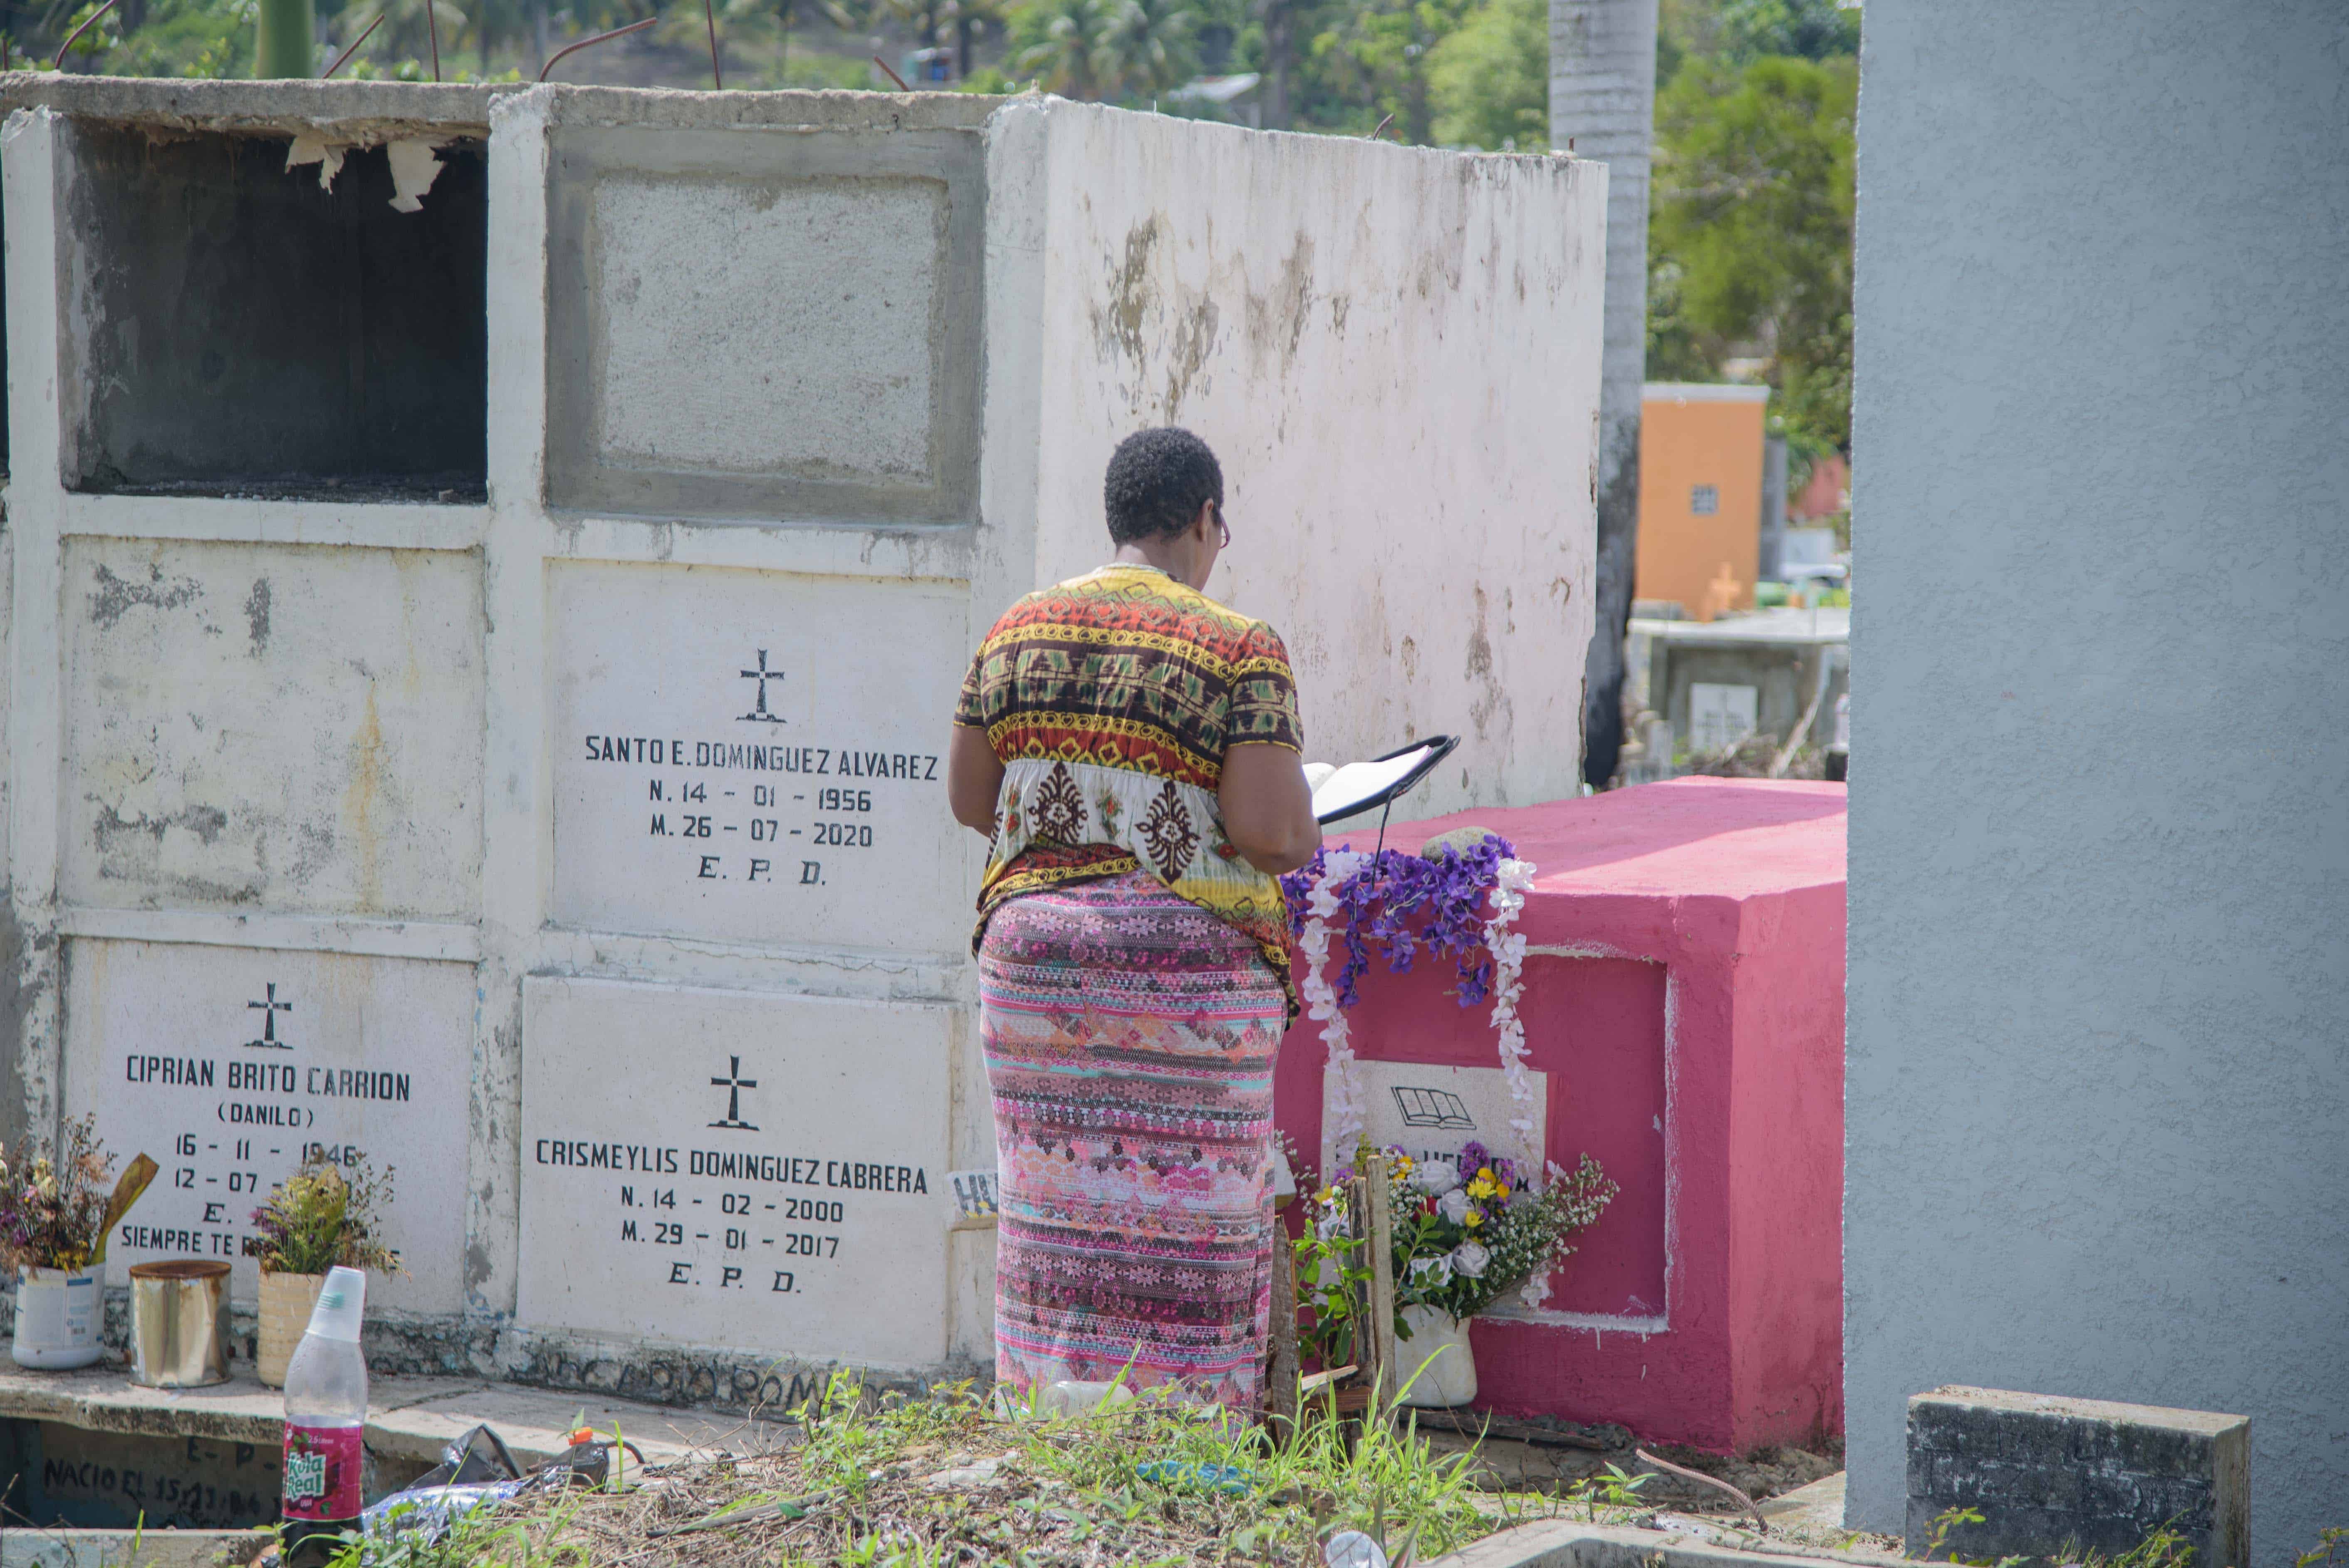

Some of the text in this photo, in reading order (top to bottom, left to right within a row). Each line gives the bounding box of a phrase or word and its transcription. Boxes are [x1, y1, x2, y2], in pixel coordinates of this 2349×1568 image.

[585, 735, 663, 764] SANTO
[696, 742, 830, 775] DOMINGUEZ
[838, 750, 938, 781] ALVAREZ
[683, 781, 708, 804] 14
[753, 784, 775, 807] 01
[819, 788, 871, 812] 1956
[683, 815, 712, 838] 26
[750, 818, 778, 842] 07
[813, 822, 872, 848] 2020
[126, 1055, 410, 1102] CIPRIAN BRITO CARRION
[218, 1103, 314, 1128] (DANILO)
[176, 1133, 196, 1156] 16
[236, 1139, 250, 1160] 11
[175, 1168, 195, 1189] 12
[229, 1172, 258, 1193] 07
[536, 1139, 928, 1195] CRISMEYLIS DOMINGUEZ CABRERA
[653, 1189, 676, 1210] 14
[721, 1193, 750, 1216] 02
[785, 1197, 844, 1223] 2000
[121, 1225, 202, 1253] SIEMPRE
[210, 1233, 233, 1256] TE
[654, 1222, 683, 1245] 29
[725, 1228, 746, 1251] 01
[785, 1233, 839, 1259] 2017
[43, 1457, 116, 1489] NACIO
[287, 1453, 323, 1478] Kola
[287, 1474, 322, 1498] Real
